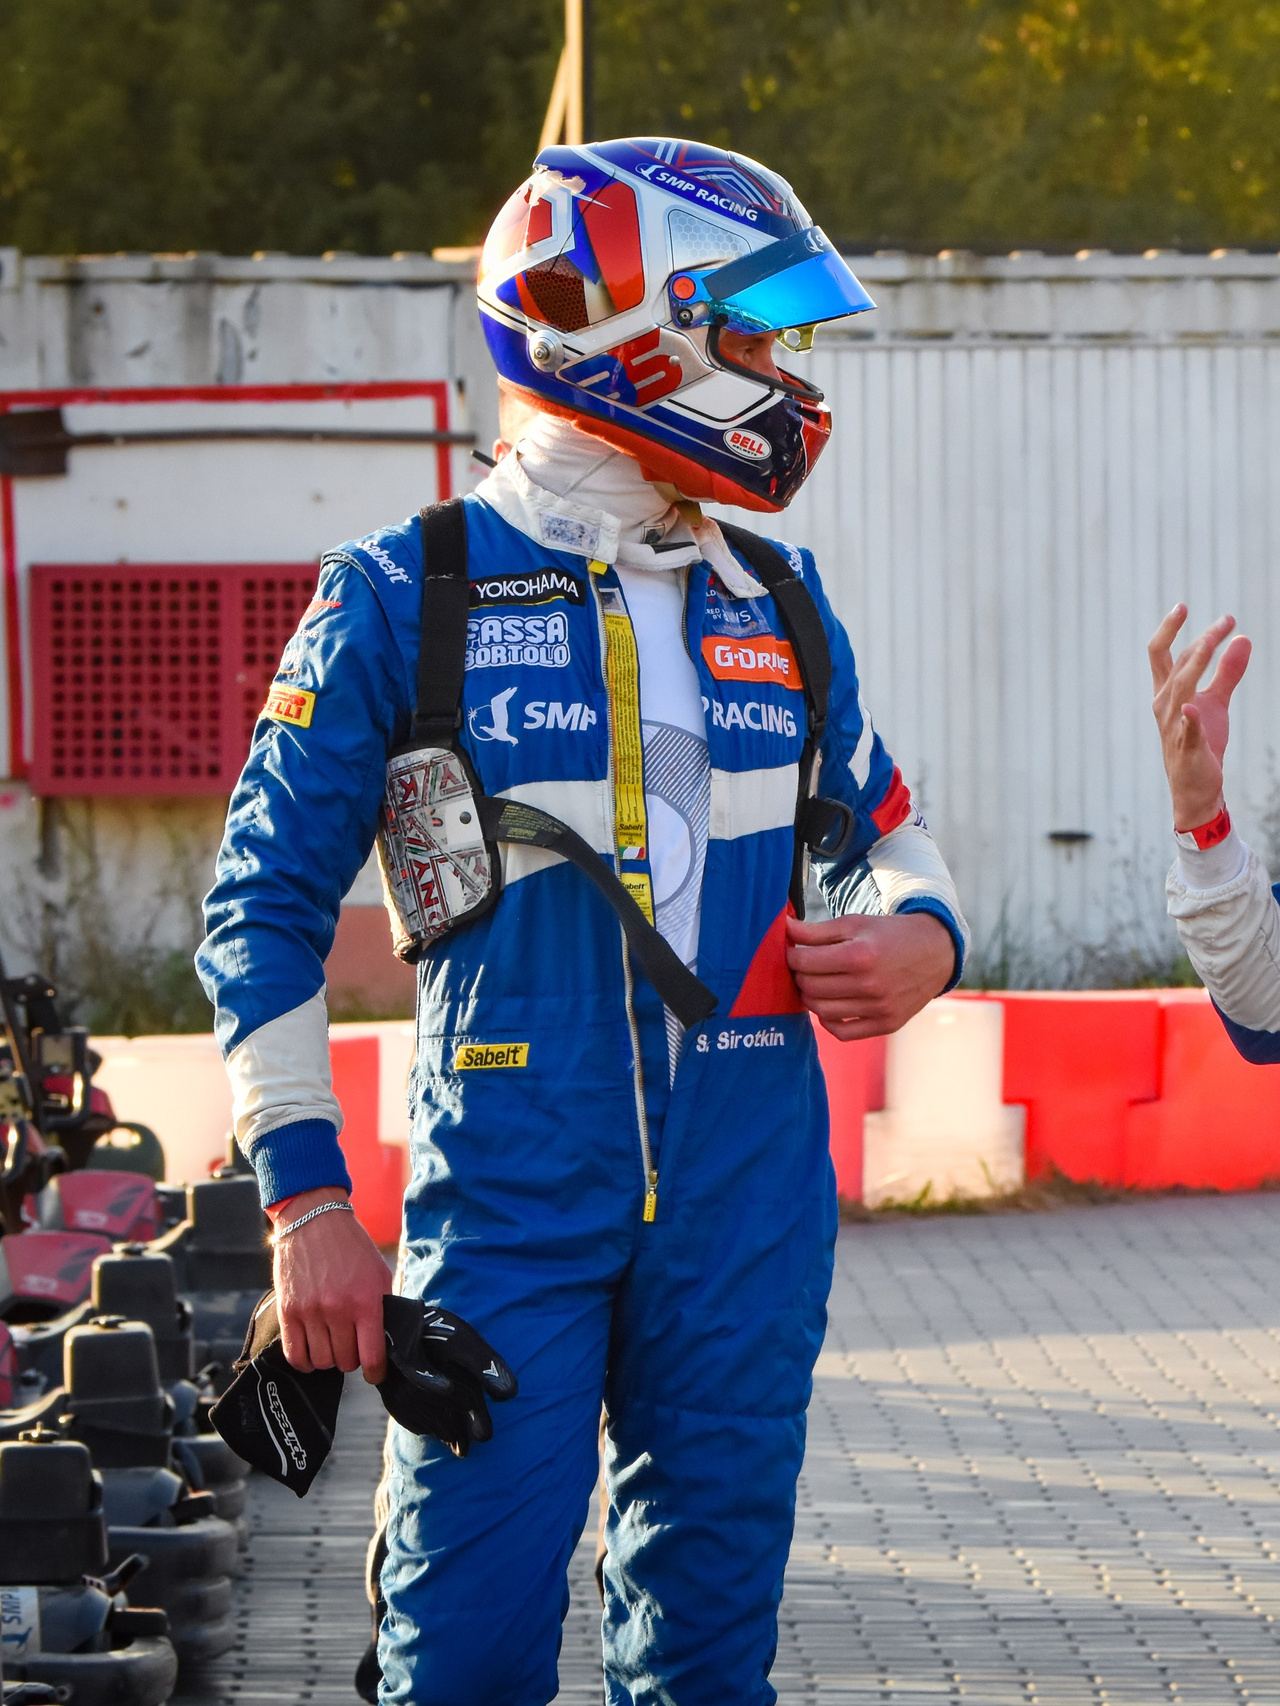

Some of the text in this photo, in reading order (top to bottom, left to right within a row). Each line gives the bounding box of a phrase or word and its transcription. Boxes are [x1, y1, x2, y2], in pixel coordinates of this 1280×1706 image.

[656, 170, 759, 222] SMP RACING
[730, 432, 765, 455] BELL
[355, 539, 410, 584] Sabelt
[475, 572, 580, 600] YOKOHAMA
[712, 698, 798, 738] RACING
[696, 1027, 786, 1054] S. Sirotkin
[462, 1046, 521, 1068] Sabelt
